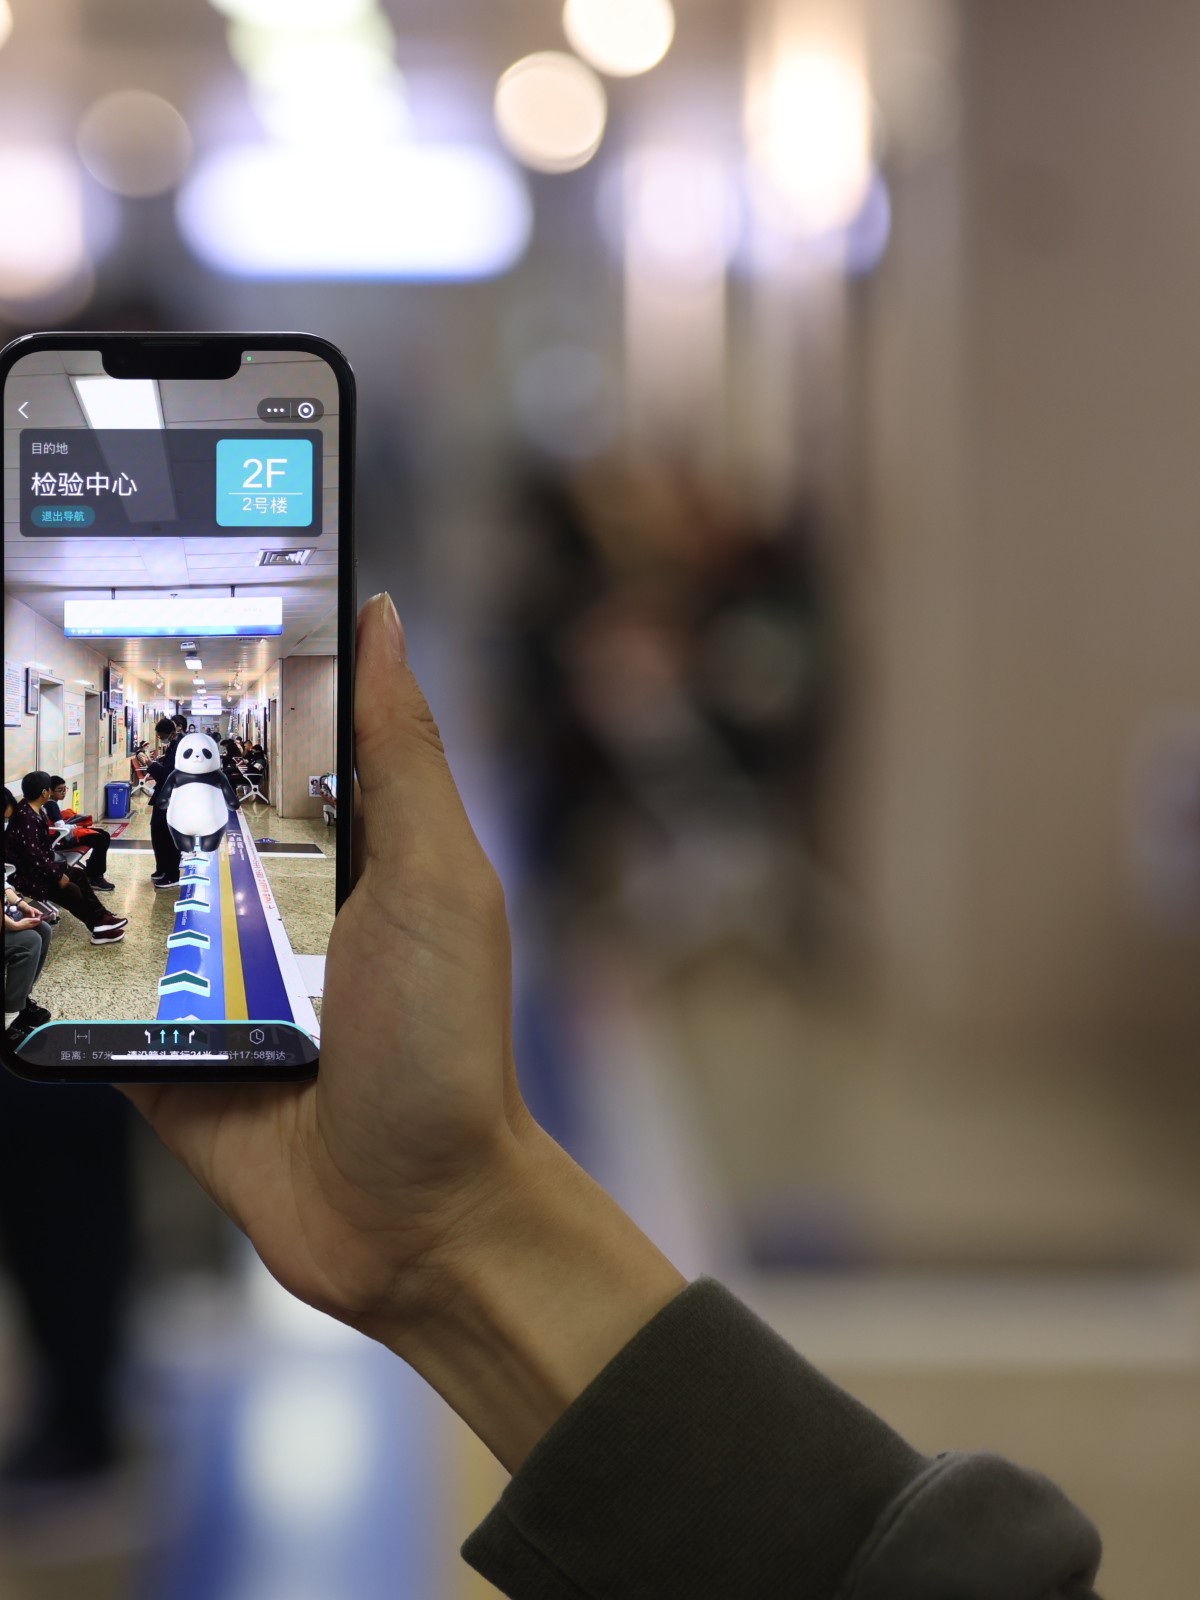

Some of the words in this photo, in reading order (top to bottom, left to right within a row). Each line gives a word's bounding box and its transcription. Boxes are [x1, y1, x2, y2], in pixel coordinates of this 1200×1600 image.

[32, 442, 68, 455] 目的地
[242, 458, 288, 489] 2F
[31, 472, 138, 497] 检验中心
[242, 497, 288, 514] 2号楼
[41, 511, 85, 522] 退出导航
